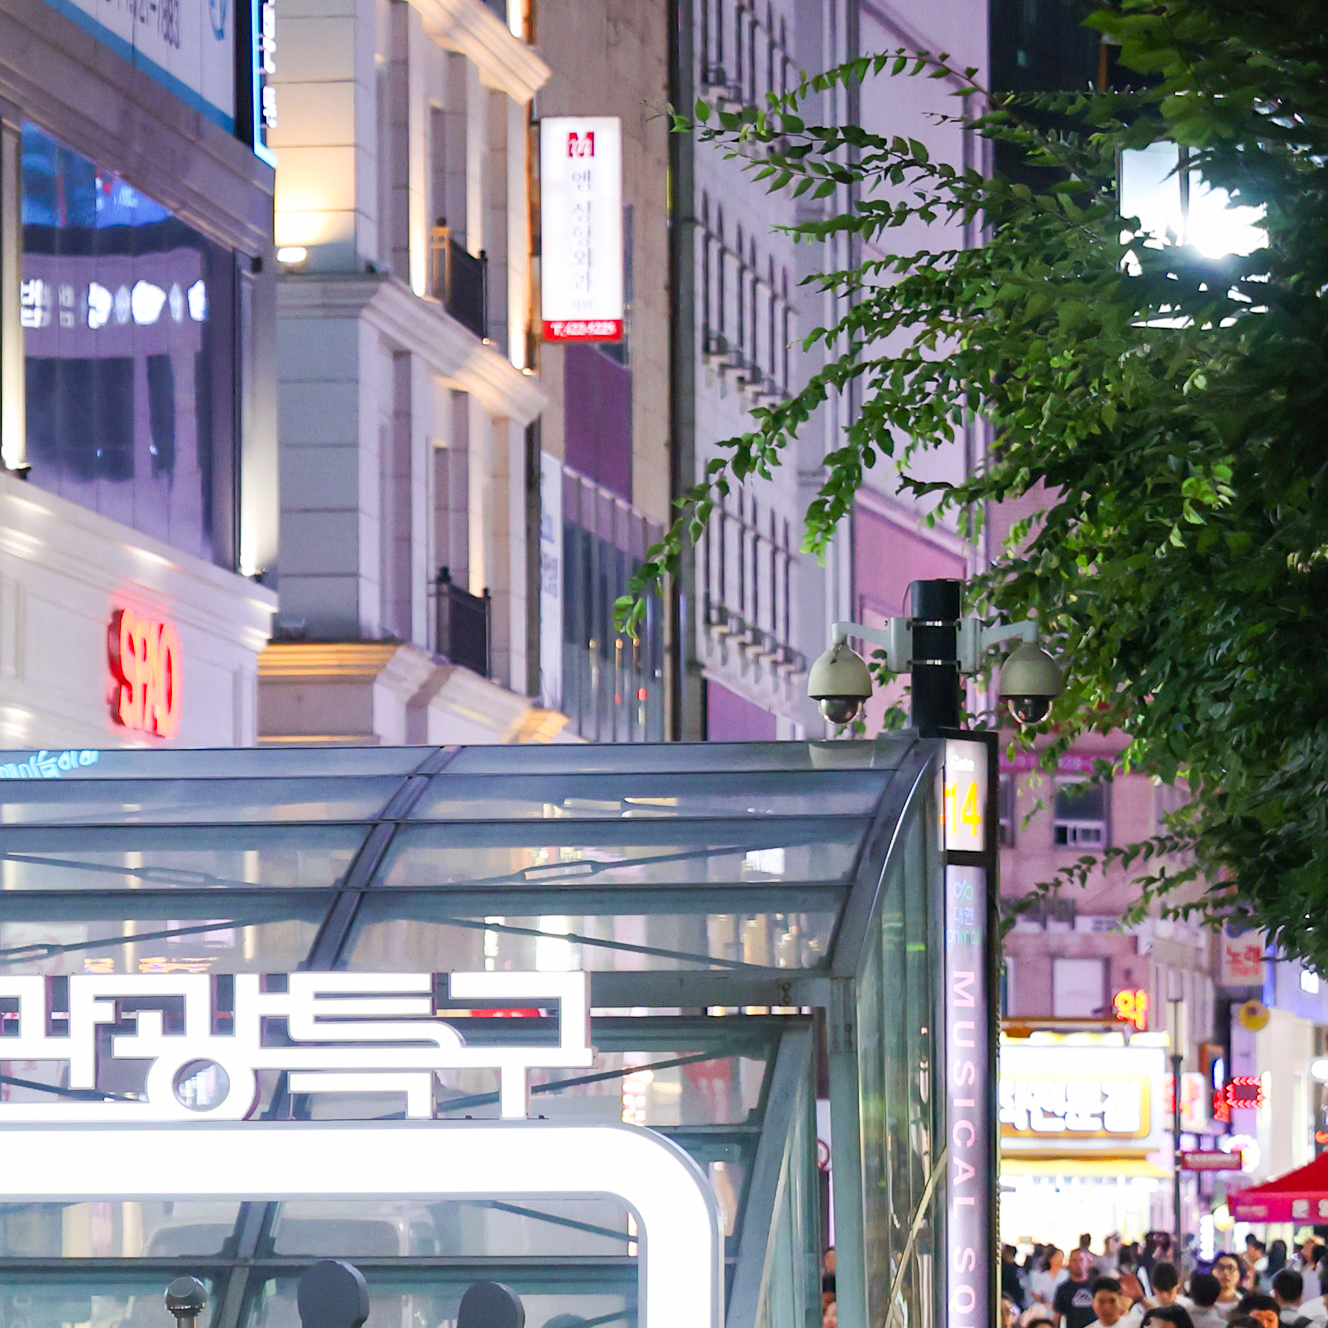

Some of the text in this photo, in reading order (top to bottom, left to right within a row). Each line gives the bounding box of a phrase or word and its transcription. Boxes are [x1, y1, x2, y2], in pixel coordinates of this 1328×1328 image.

[118, 607, 183, 741] SPAO
[950, 754, 975, 773] Gate
[943, 780, 982, 836] 14
[1114, 988, 1151, 1031] 약
[952, 970, 976, 1219] MUSICAL
